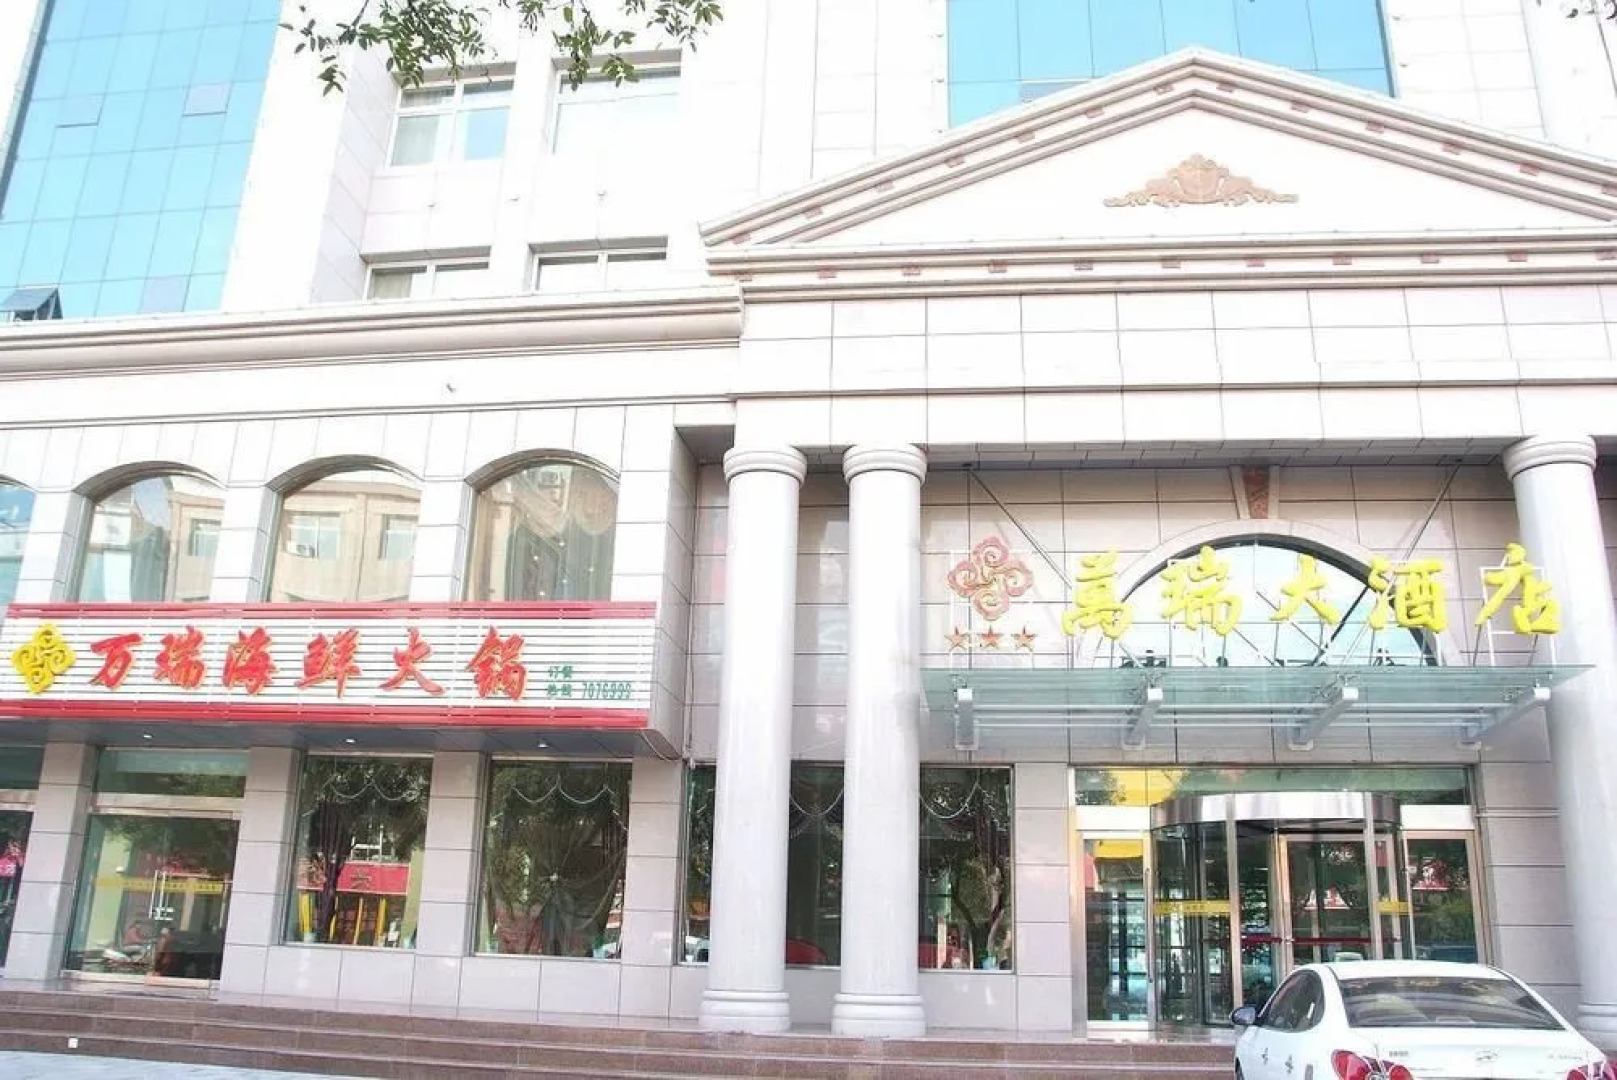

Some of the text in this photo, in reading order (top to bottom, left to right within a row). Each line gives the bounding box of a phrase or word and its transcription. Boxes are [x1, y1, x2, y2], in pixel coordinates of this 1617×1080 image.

[89, 625, 527, 699] 万瑞海鲜火锅
